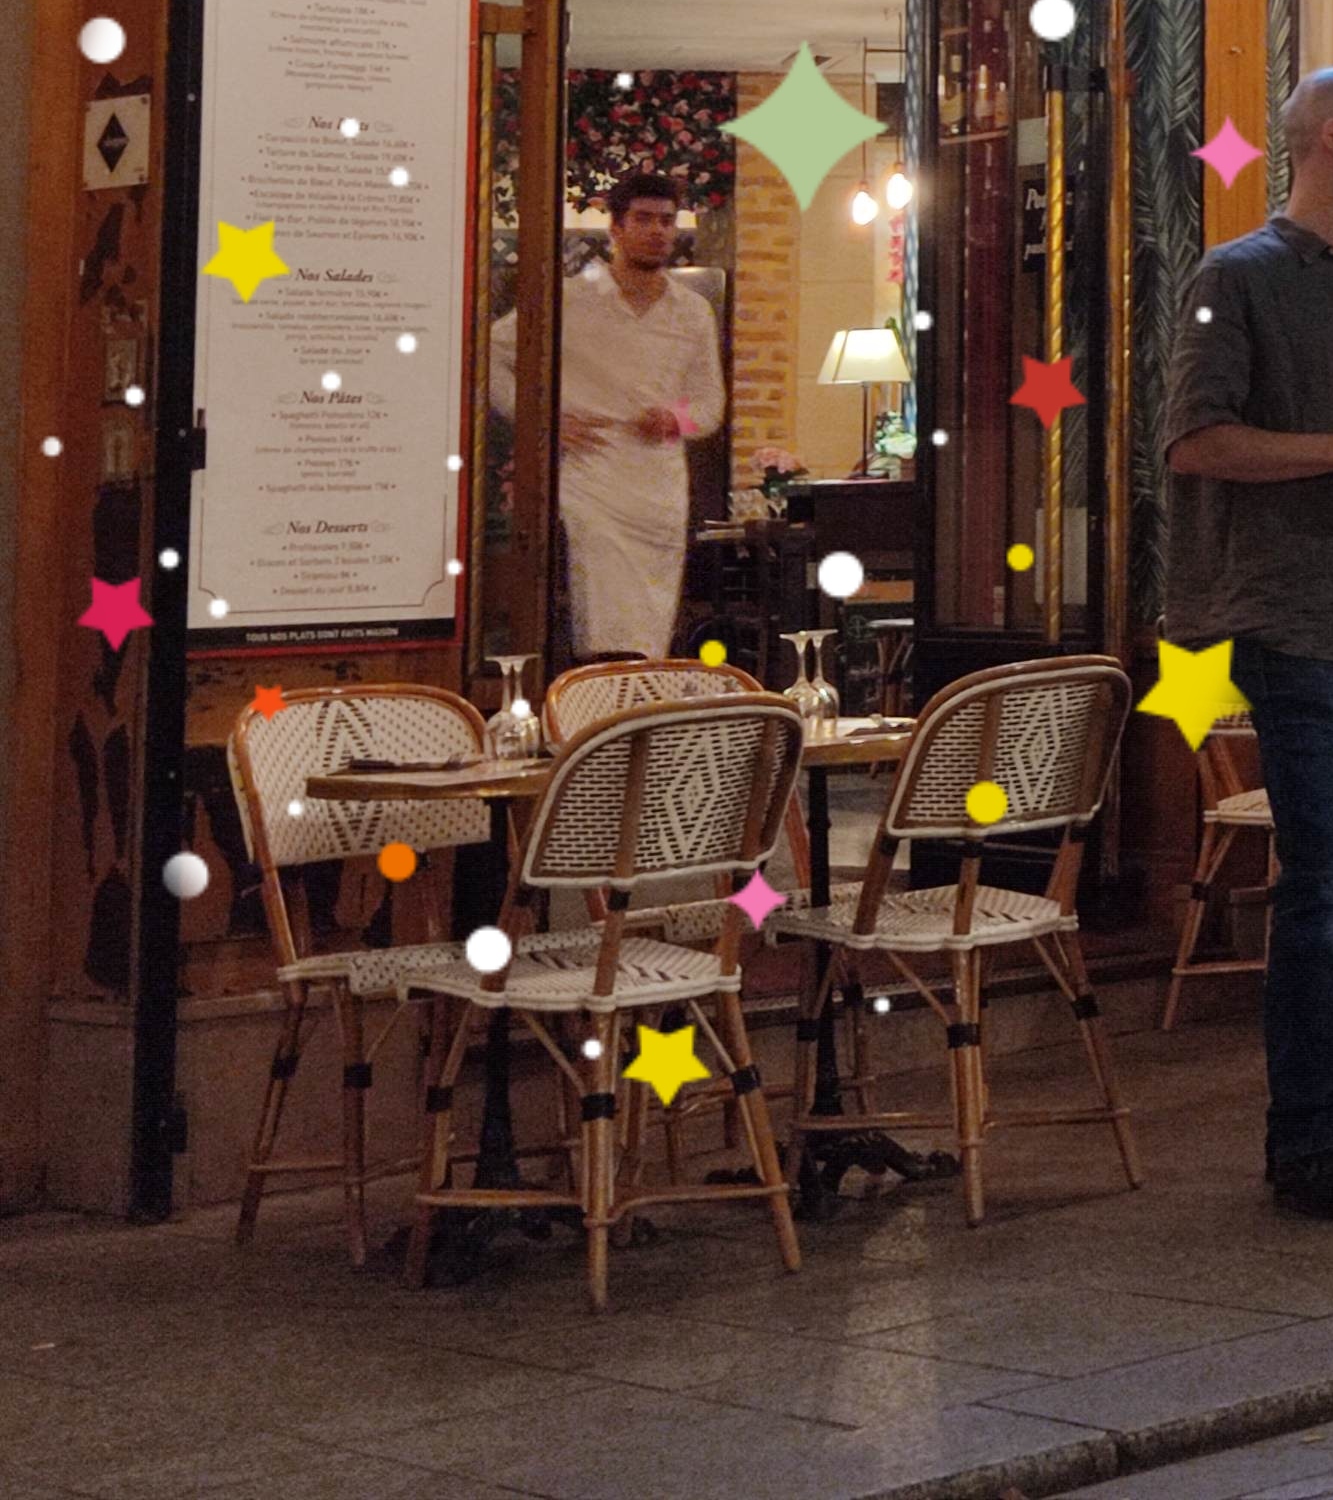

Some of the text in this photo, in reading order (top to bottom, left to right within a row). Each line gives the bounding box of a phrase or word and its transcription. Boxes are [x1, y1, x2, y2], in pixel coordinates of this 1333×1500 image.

[308, 116, 333, 130] Nos
[295, 268, 374, 283] Nos Salades
[300, 390, 362, 404] Nos Pâtes
[286, 520, 368, 534] Nos Desserts
